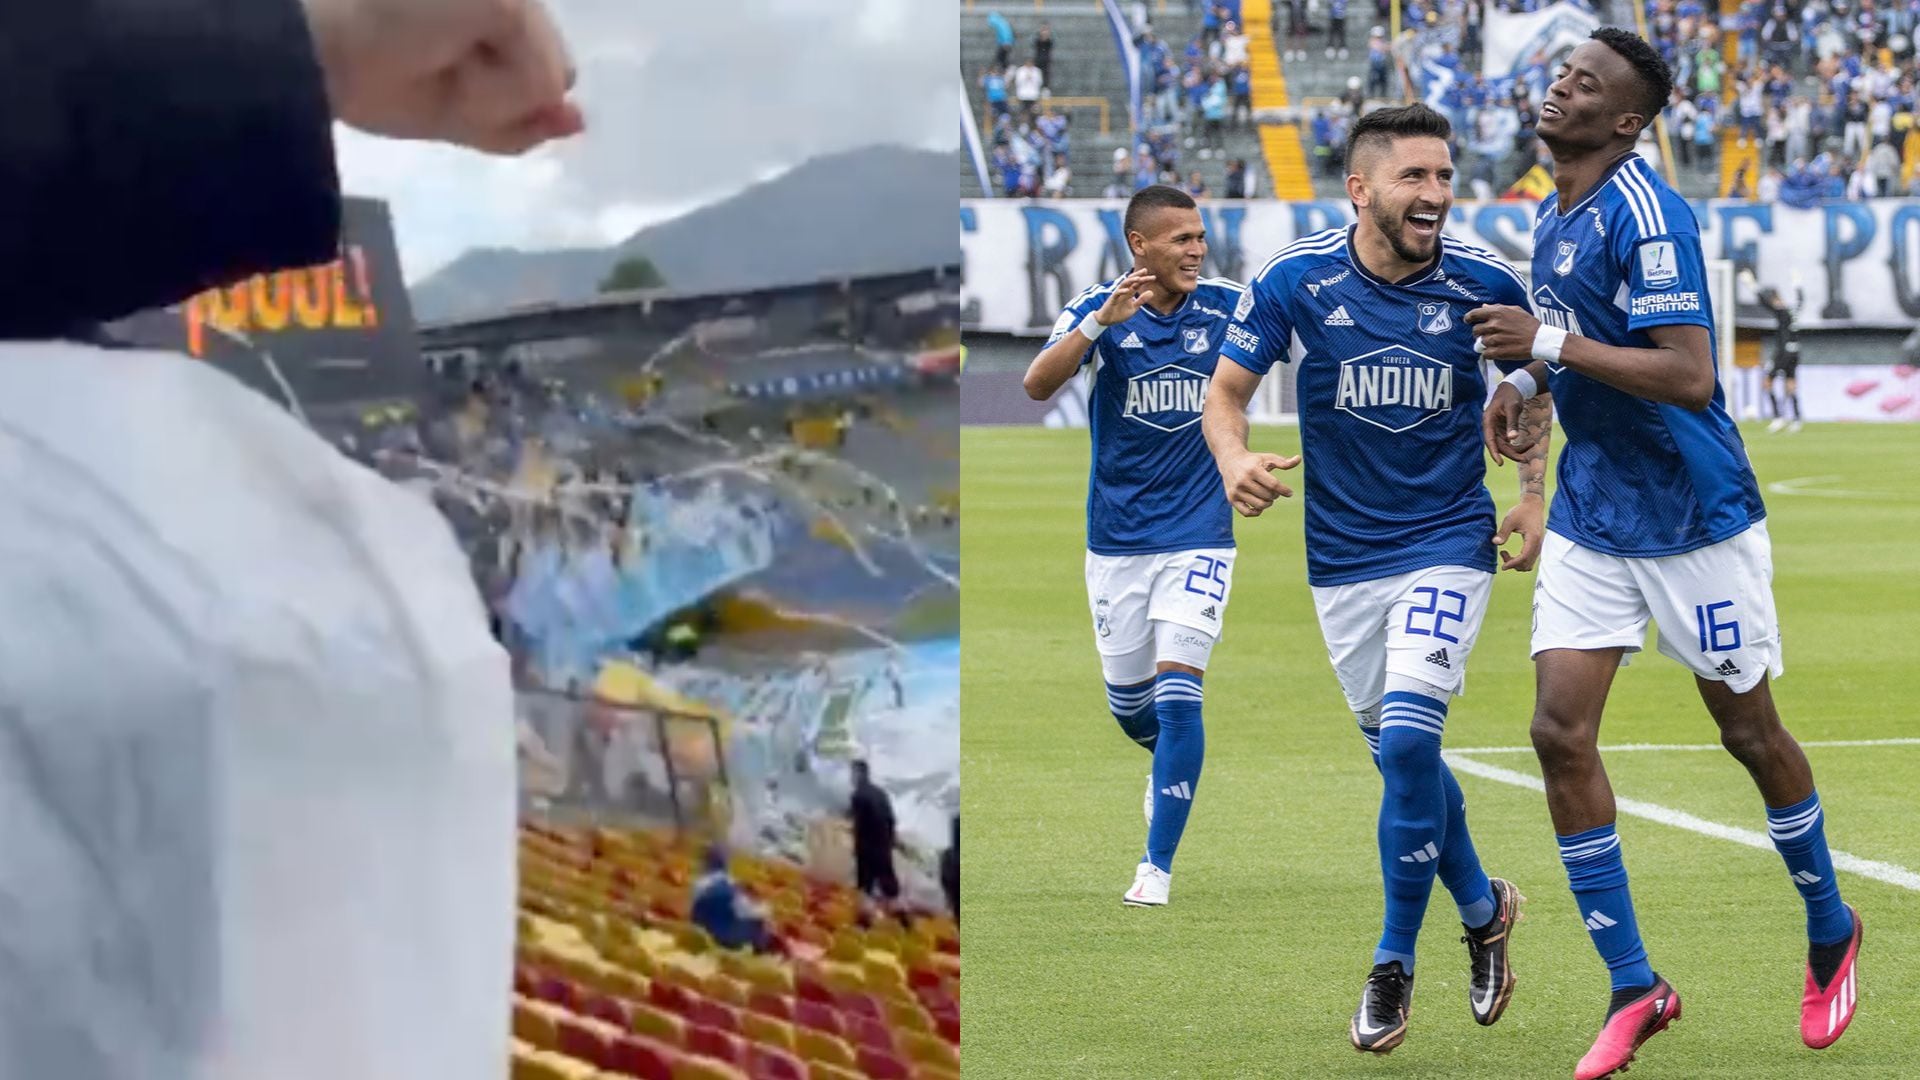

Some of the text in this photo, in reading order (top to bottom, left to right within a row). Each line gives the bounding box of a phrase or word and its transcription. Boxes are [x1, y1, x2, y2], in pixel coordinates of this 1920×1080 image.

[1647, 268, 1672, 277] BetPlay
[1632, 292, 1698, 307] HERBALIFE
[1632, 301, 1699, 316] NUTRITION
[1382, 356, 1410, 365] CERVEZA
[1338, 365, 1451, 409] ANDINA
[1184, 555, 1228, 603] 25
[1405, 586, 1467, 645] 22
[1696, 600, 1741, 652] 16
[1425, 656, 1451, 670] adidas
